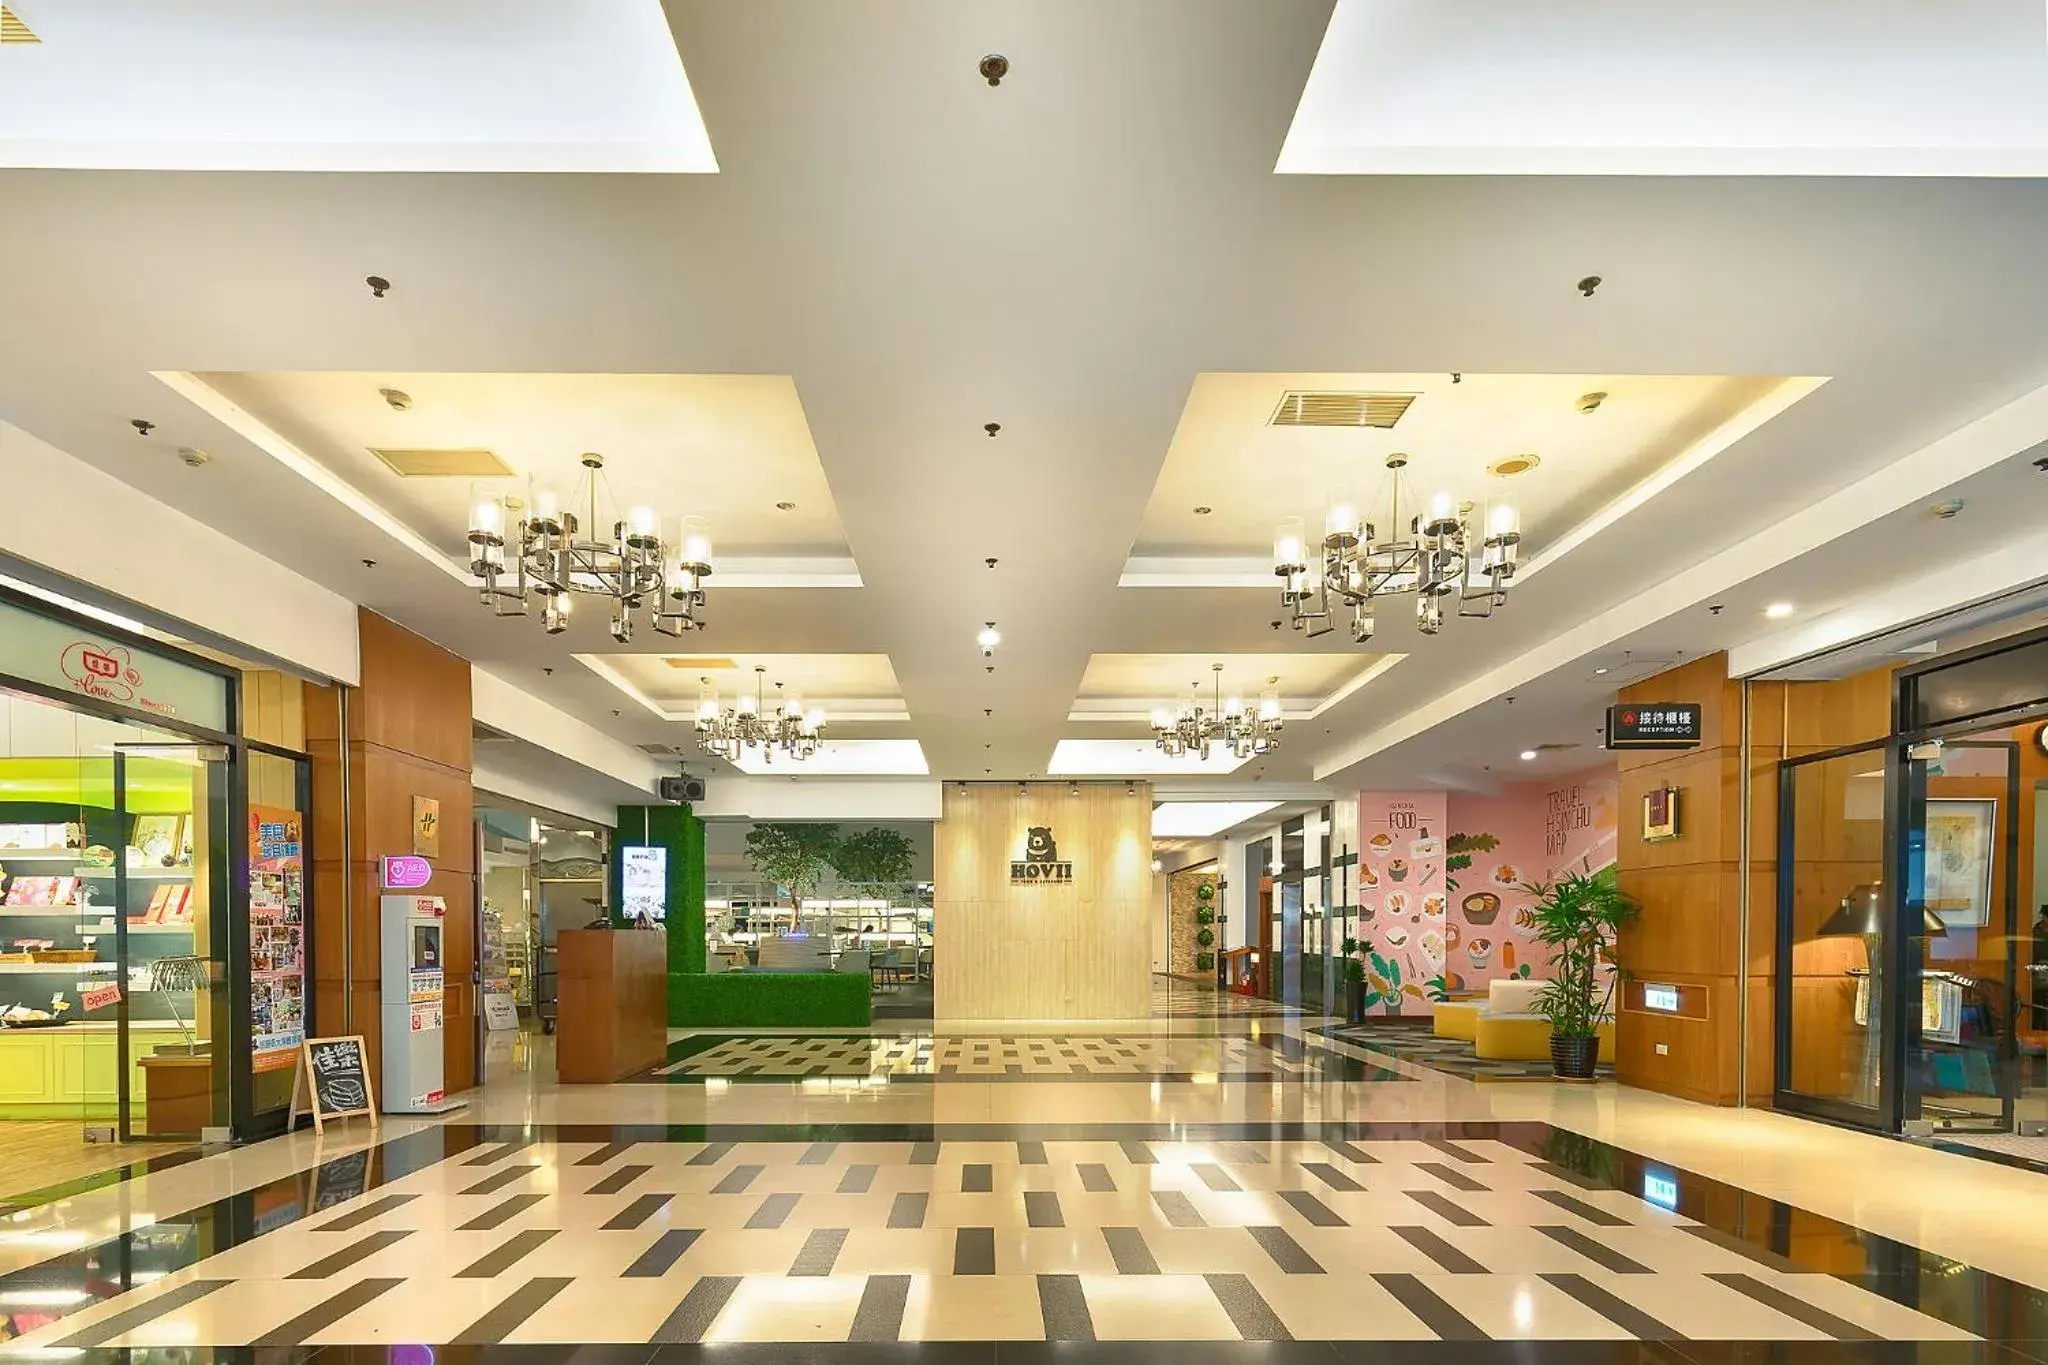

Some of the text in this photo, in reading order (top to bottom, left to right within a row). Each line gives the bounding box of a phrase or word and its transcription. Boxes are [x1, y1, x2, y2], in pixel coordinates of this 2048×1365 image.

[1389, 811, 1417, 830] FOOD
[1546, 806, 1591, 834] HSINCHU
[407, 863, 426, 873] AED
[87, 990, 117, 1006] open
